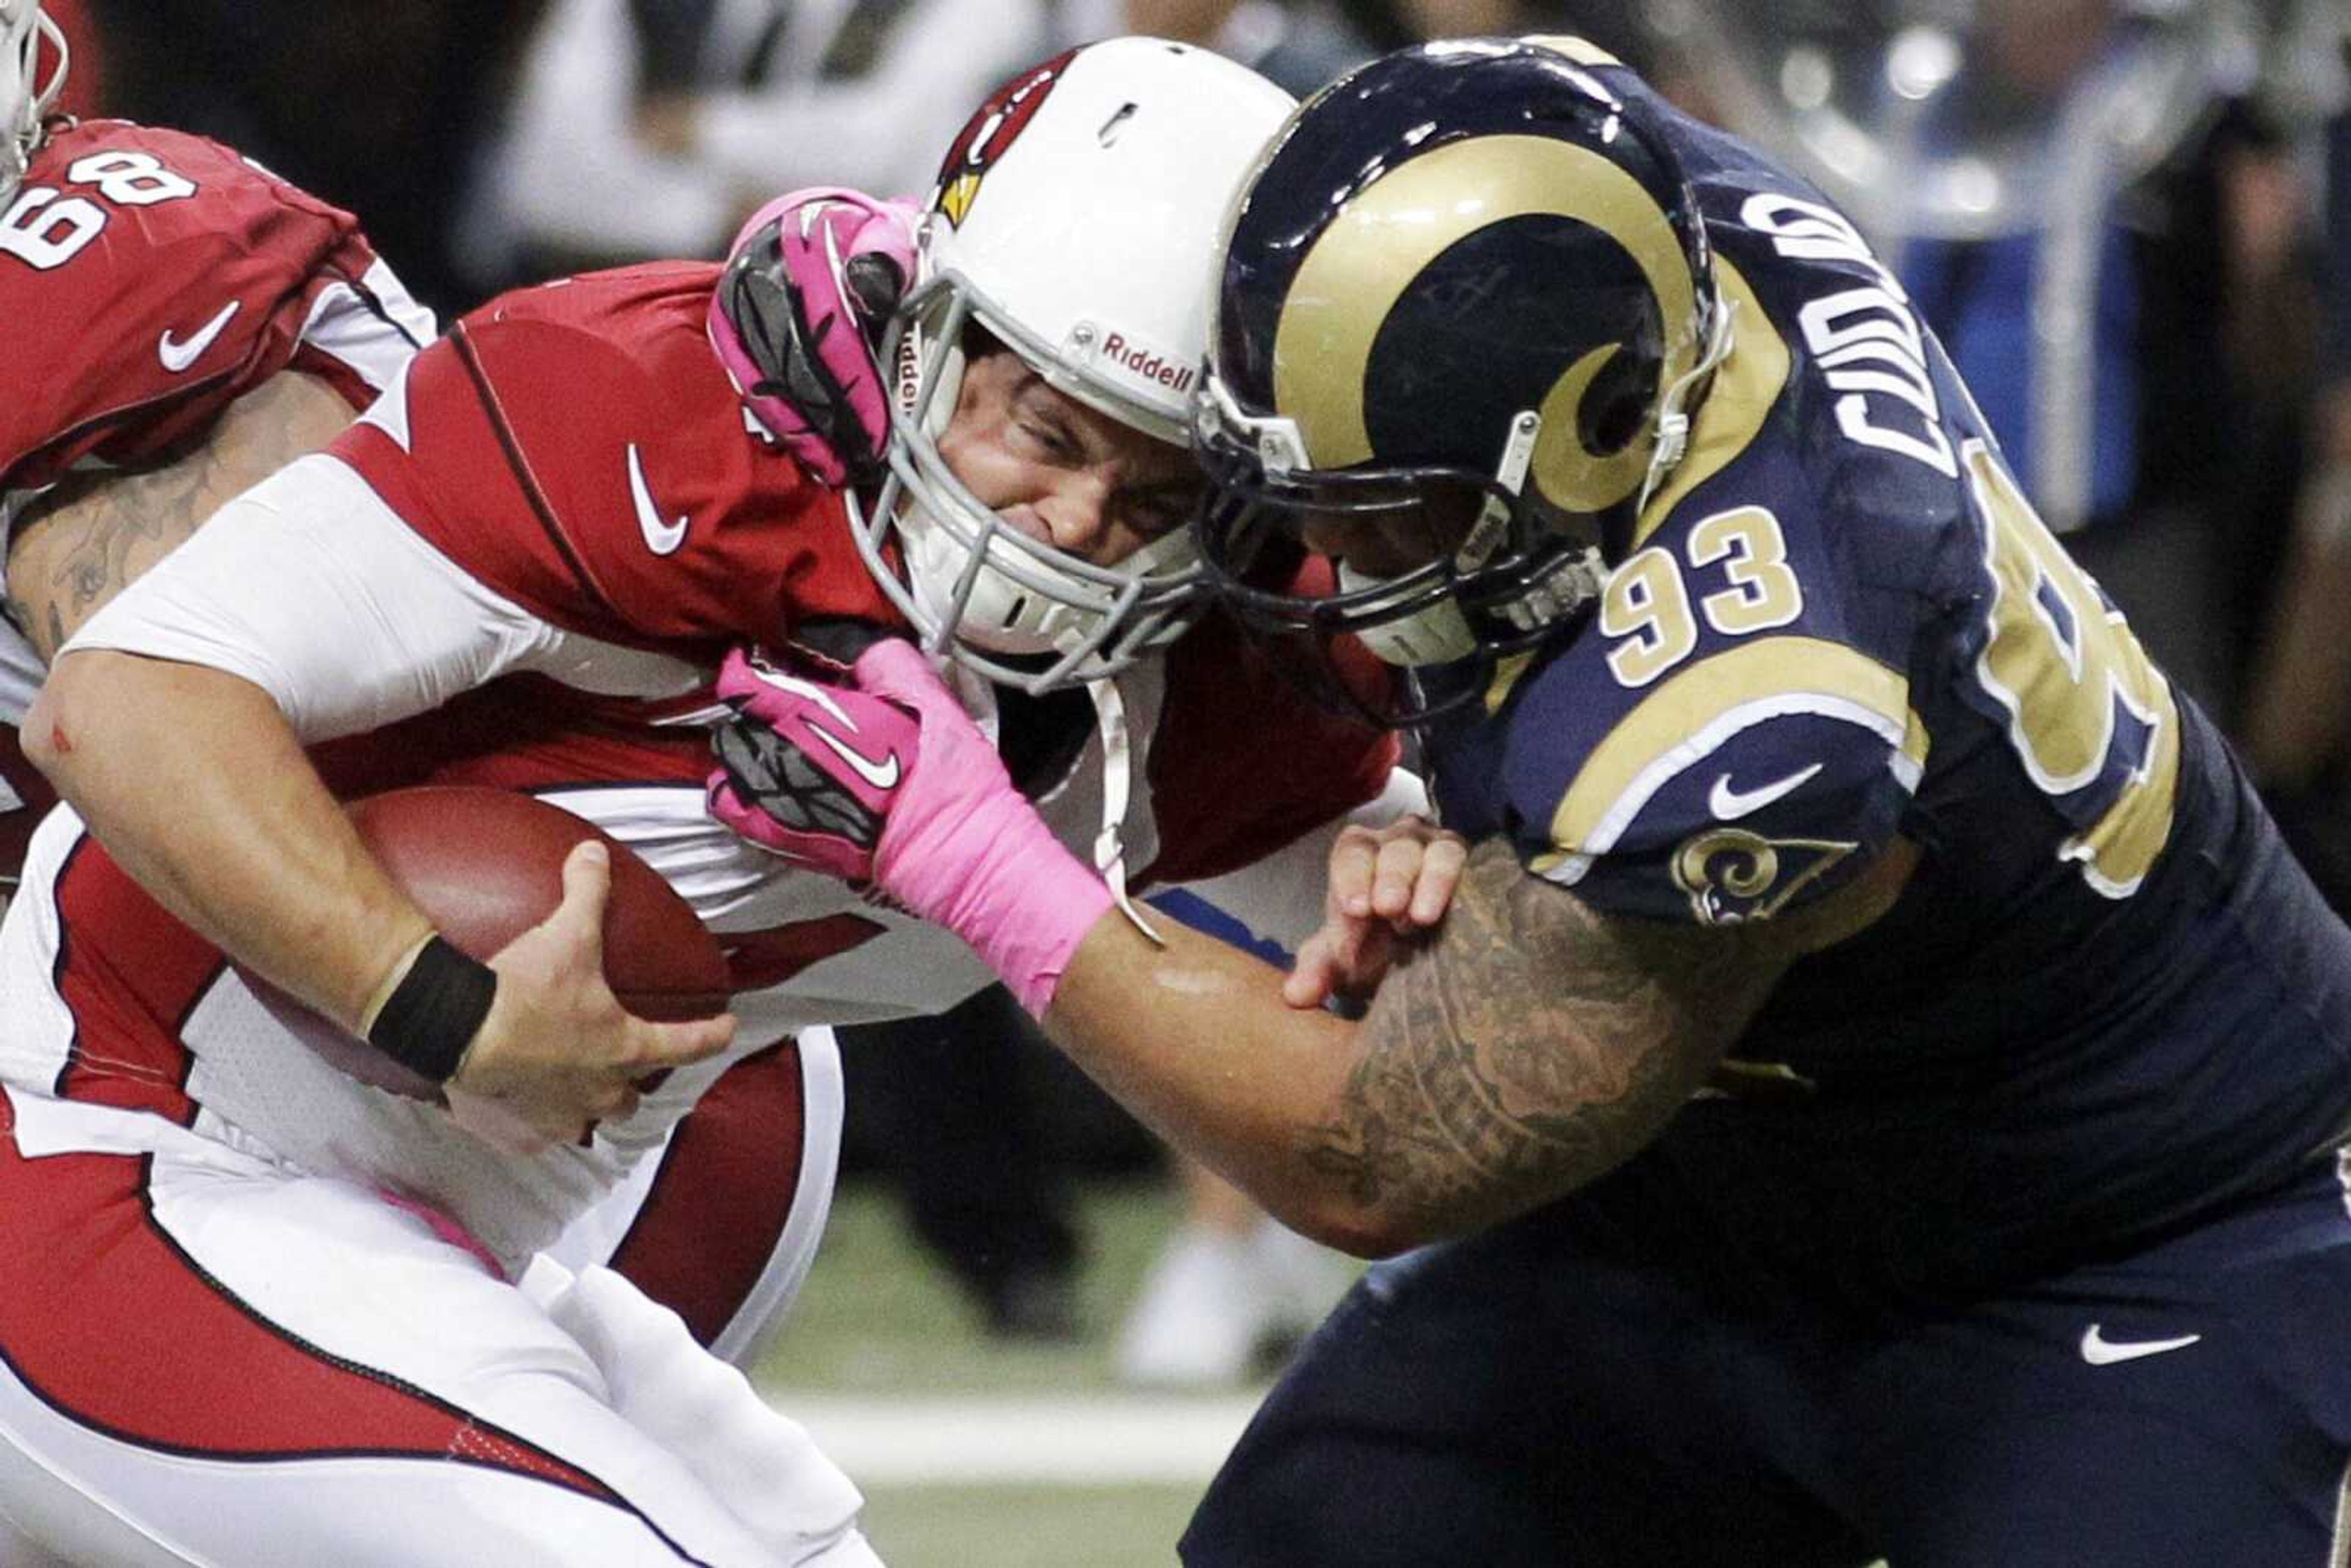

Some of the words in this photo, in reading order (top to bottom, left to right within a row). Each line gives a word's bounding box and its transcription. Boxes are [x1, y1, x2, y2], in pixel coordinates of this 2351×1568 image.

[0, 151, 200, 270] 68
[902, 334, 918, 418] iddel
[1102, 332, 1194, 393] Riddell
[1740, 192, 1958, 478] CUDJO
[1600, 505, 1804, 688] 93
